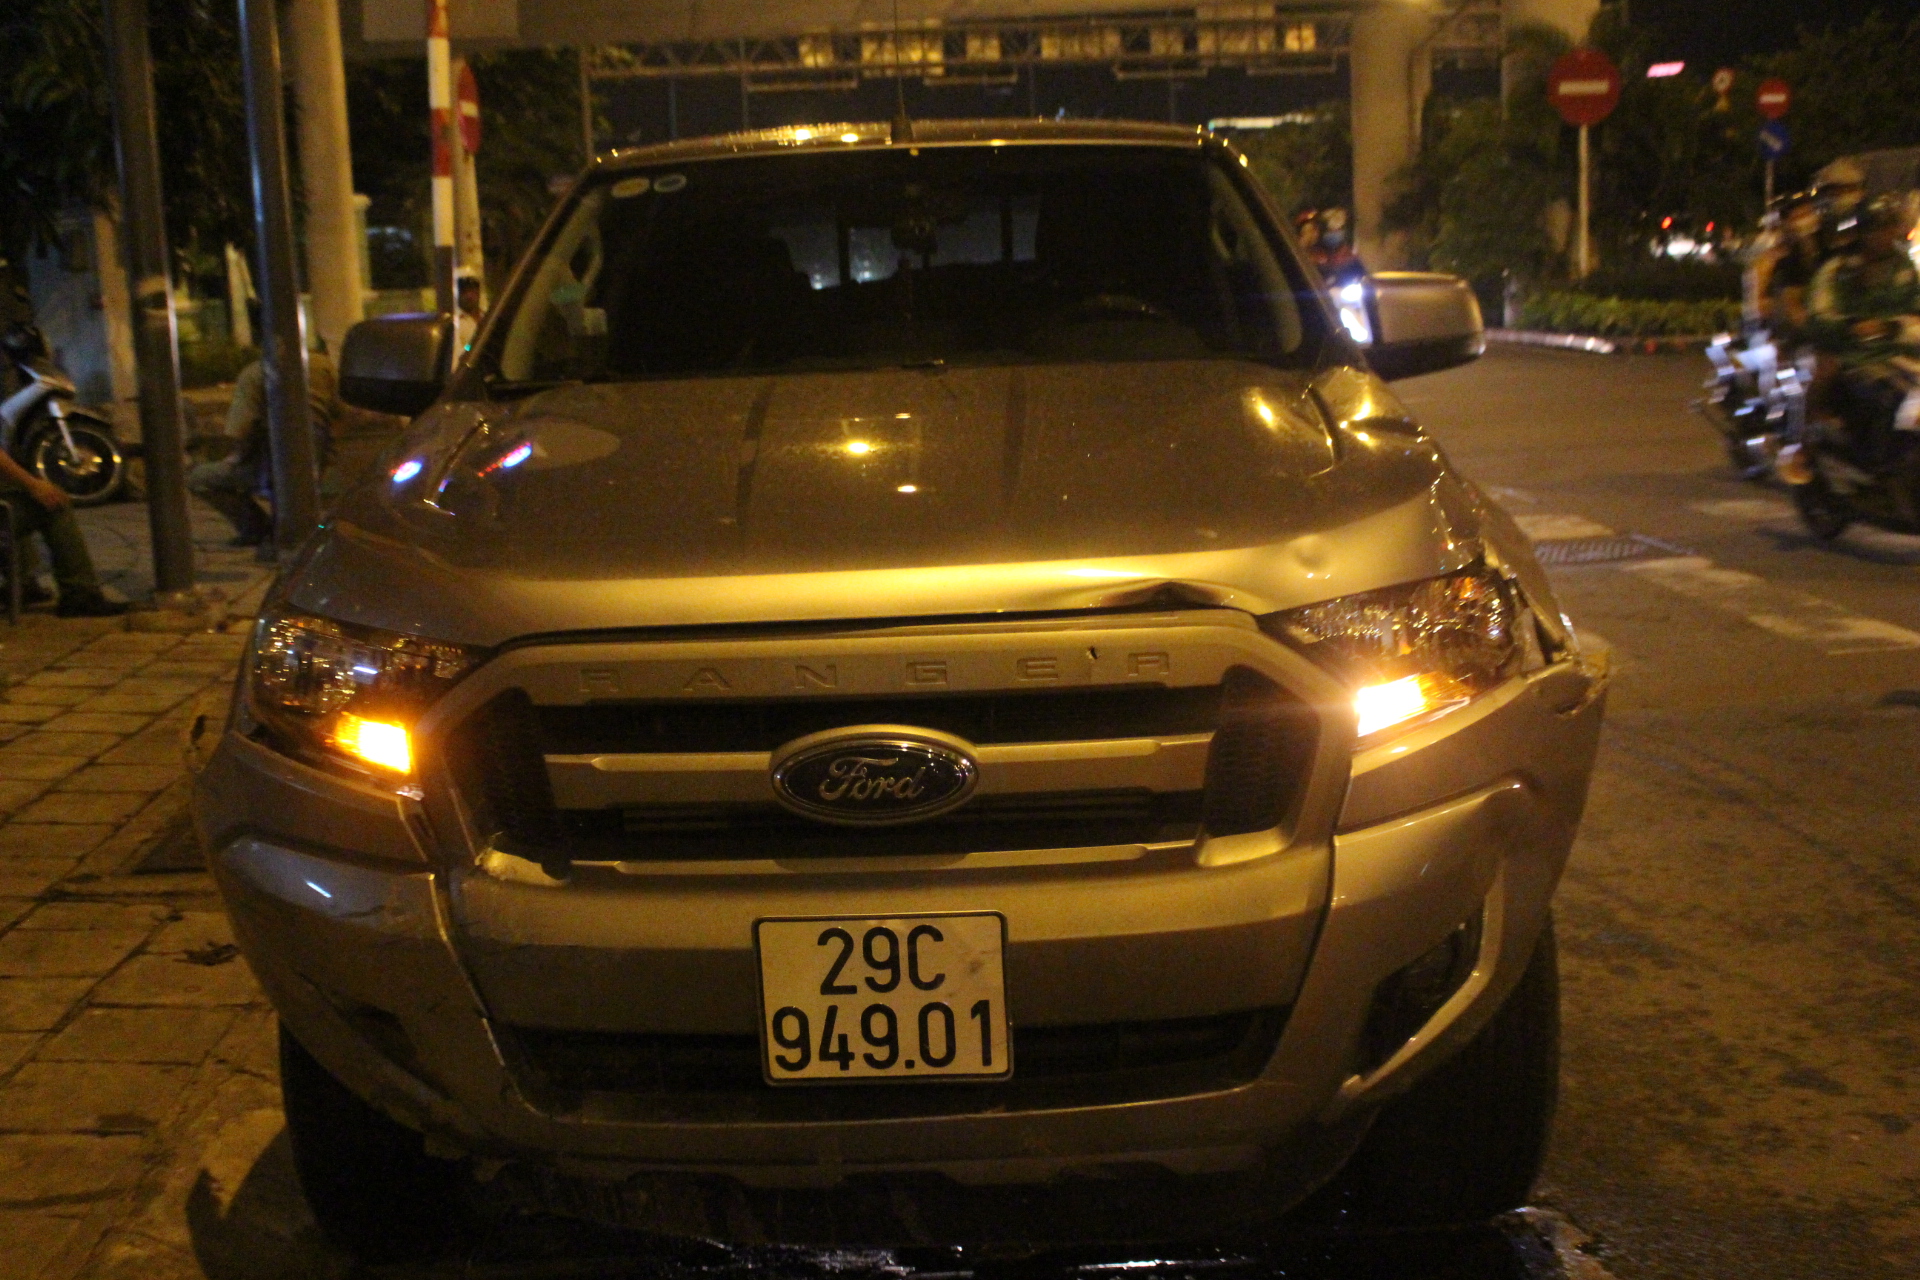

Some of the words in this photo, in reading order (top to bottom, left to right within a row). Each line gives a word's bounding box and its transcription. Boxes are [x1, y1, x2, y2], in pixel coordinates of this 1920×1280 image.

[580, 651, 1171, 693] RANGER
[818, 756, 925, 802] Ford
[817, 924, 946, 995] 29C
[772, 1000, 993, 1072] 949.01
